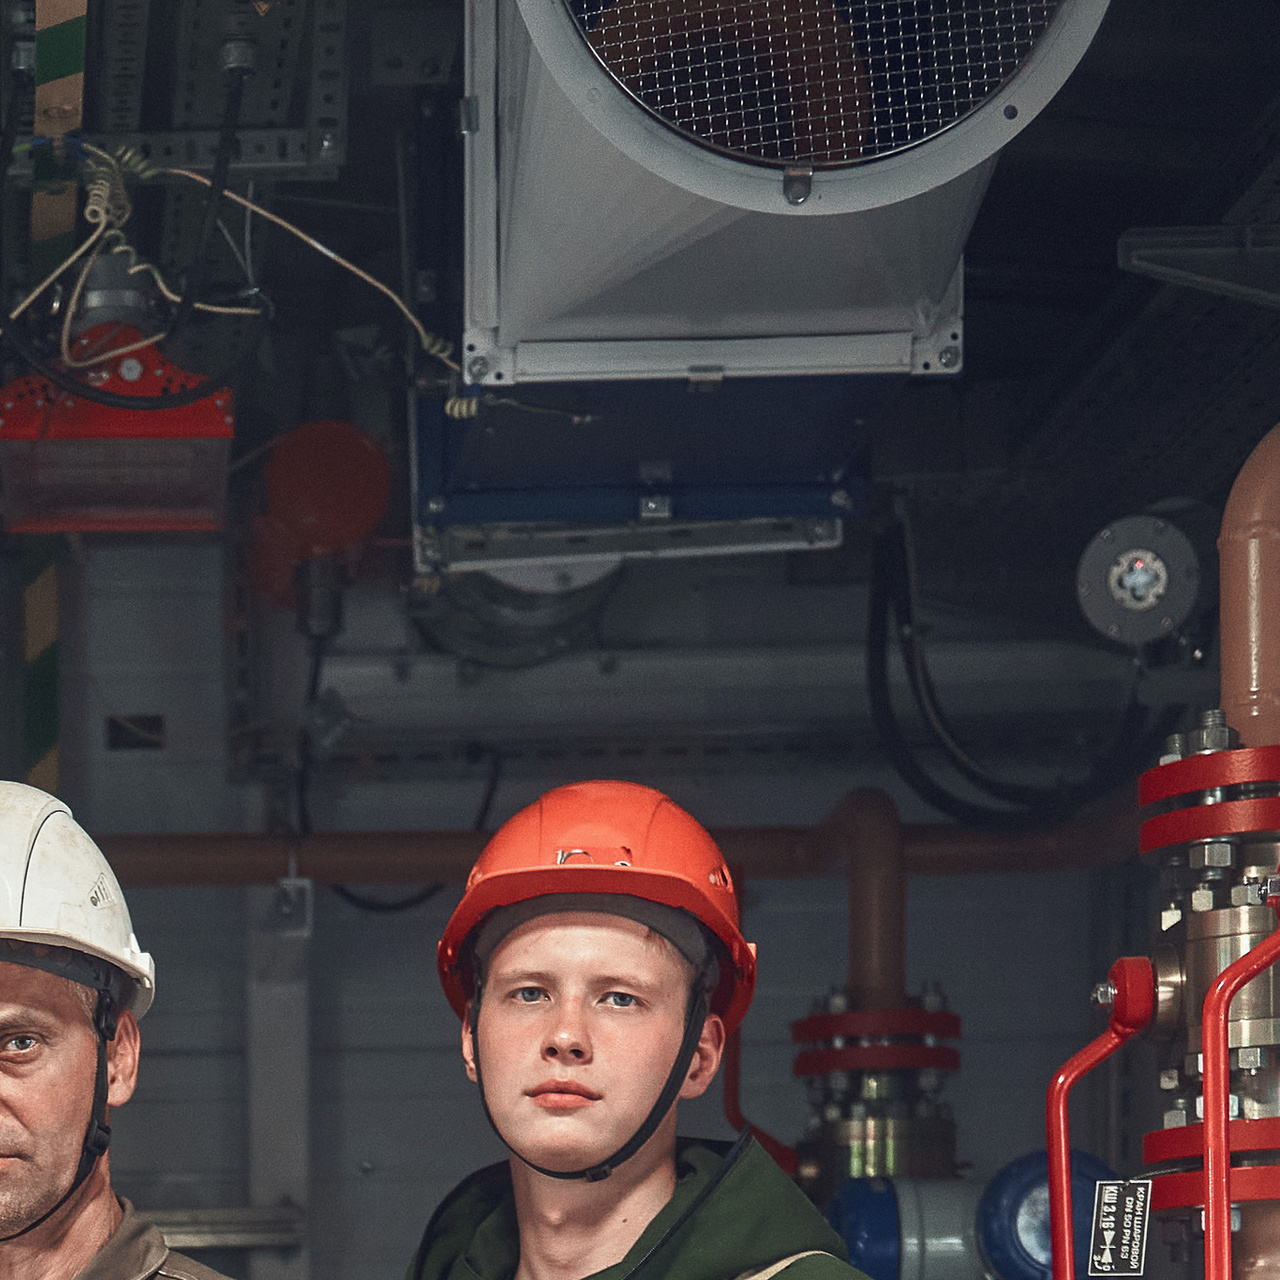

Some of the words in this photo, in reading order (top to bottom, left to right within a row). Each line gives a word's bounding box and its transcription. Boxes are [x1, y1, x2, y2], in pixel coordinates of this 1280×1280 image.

[1104, 1185, 1118, 1204] КШ
[1135, 1186, 1146, 1216] КРАН
[1130, 1216, 1143, 1269] ШАРОВОЙ
